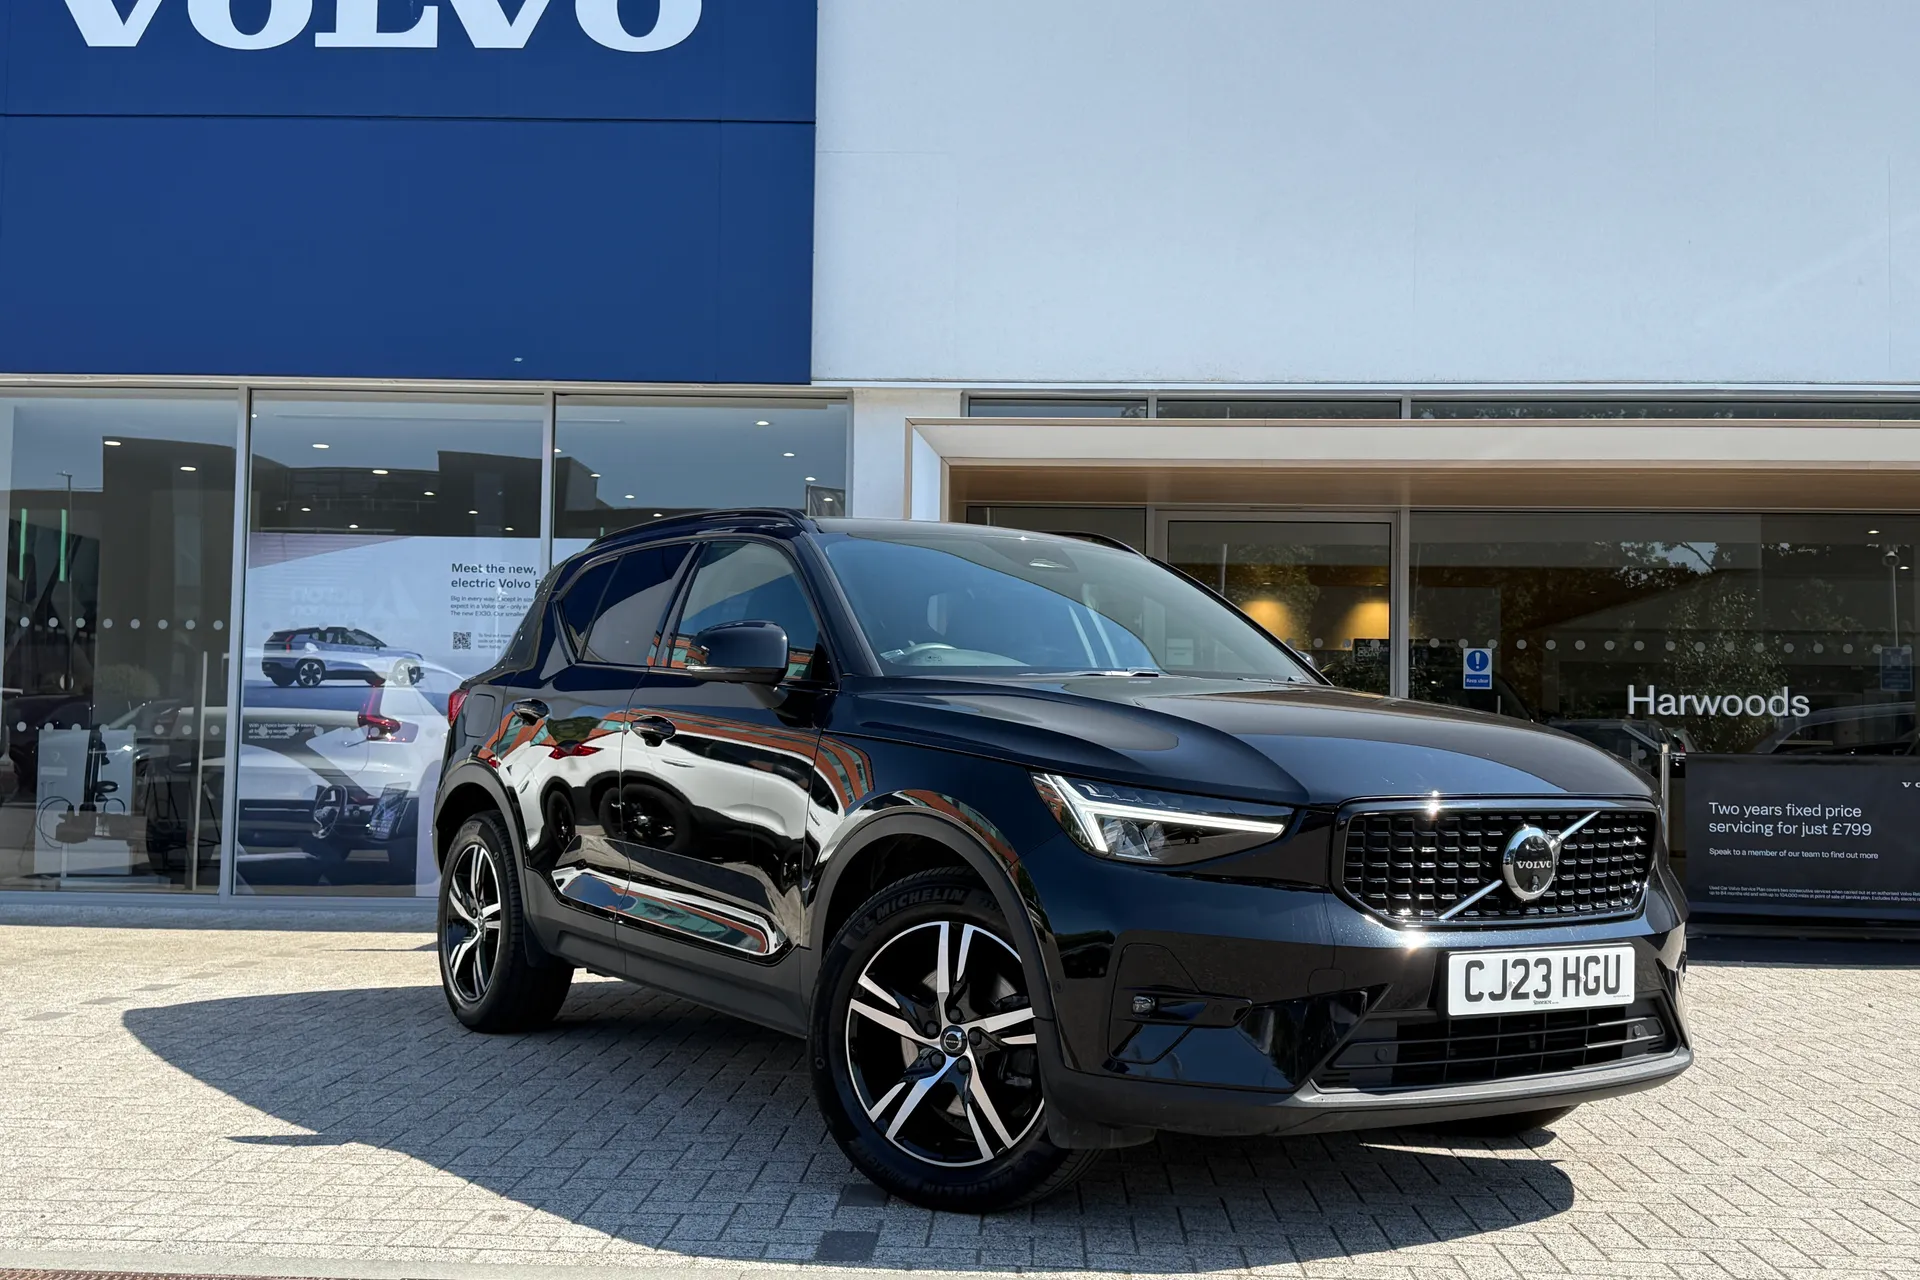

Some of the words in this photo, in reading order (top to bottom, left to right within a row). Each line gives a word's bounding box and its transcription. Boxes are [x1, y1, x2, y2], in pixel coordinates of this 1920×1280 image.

[66, 0, 702, 53] VOLVO
[451, 563, 483, 574] Meet
[486, 563, 505, 574] the
[508, 565, 537, 576] new,
[451, 577, 496, 588] electric
[499, 579, 531, 589] Volvo
[1627, 684, 1810, 717] Harwoods
[1708, 802, 1740, 815] Two
[1743, 804, 1783, 818] years
[1785, 803, 1822, 817] fixed
[1825, 804, 1862, 820] price
[1708, 821, 1774, 837] servicing
[1777, 821, 1798, 834] for
[1801, 822, 1828, 837] just
[1832, 823, 1872, 836] £799
[1709, 848, 1732, 857] Speak
[1748, 849, 1778, 857] member
[1779, 849, 1787, 857] of
[1801, 850, 1821, 858] team
[1830, 851, 1845, 859] find
[1516, 860, 1552, 870] VOLVO
[876, 888, 966, 919] MICHELIN
[1465, 957, 1552, 1003] CJ23
[1562, 954, 1621, 998] HGU
